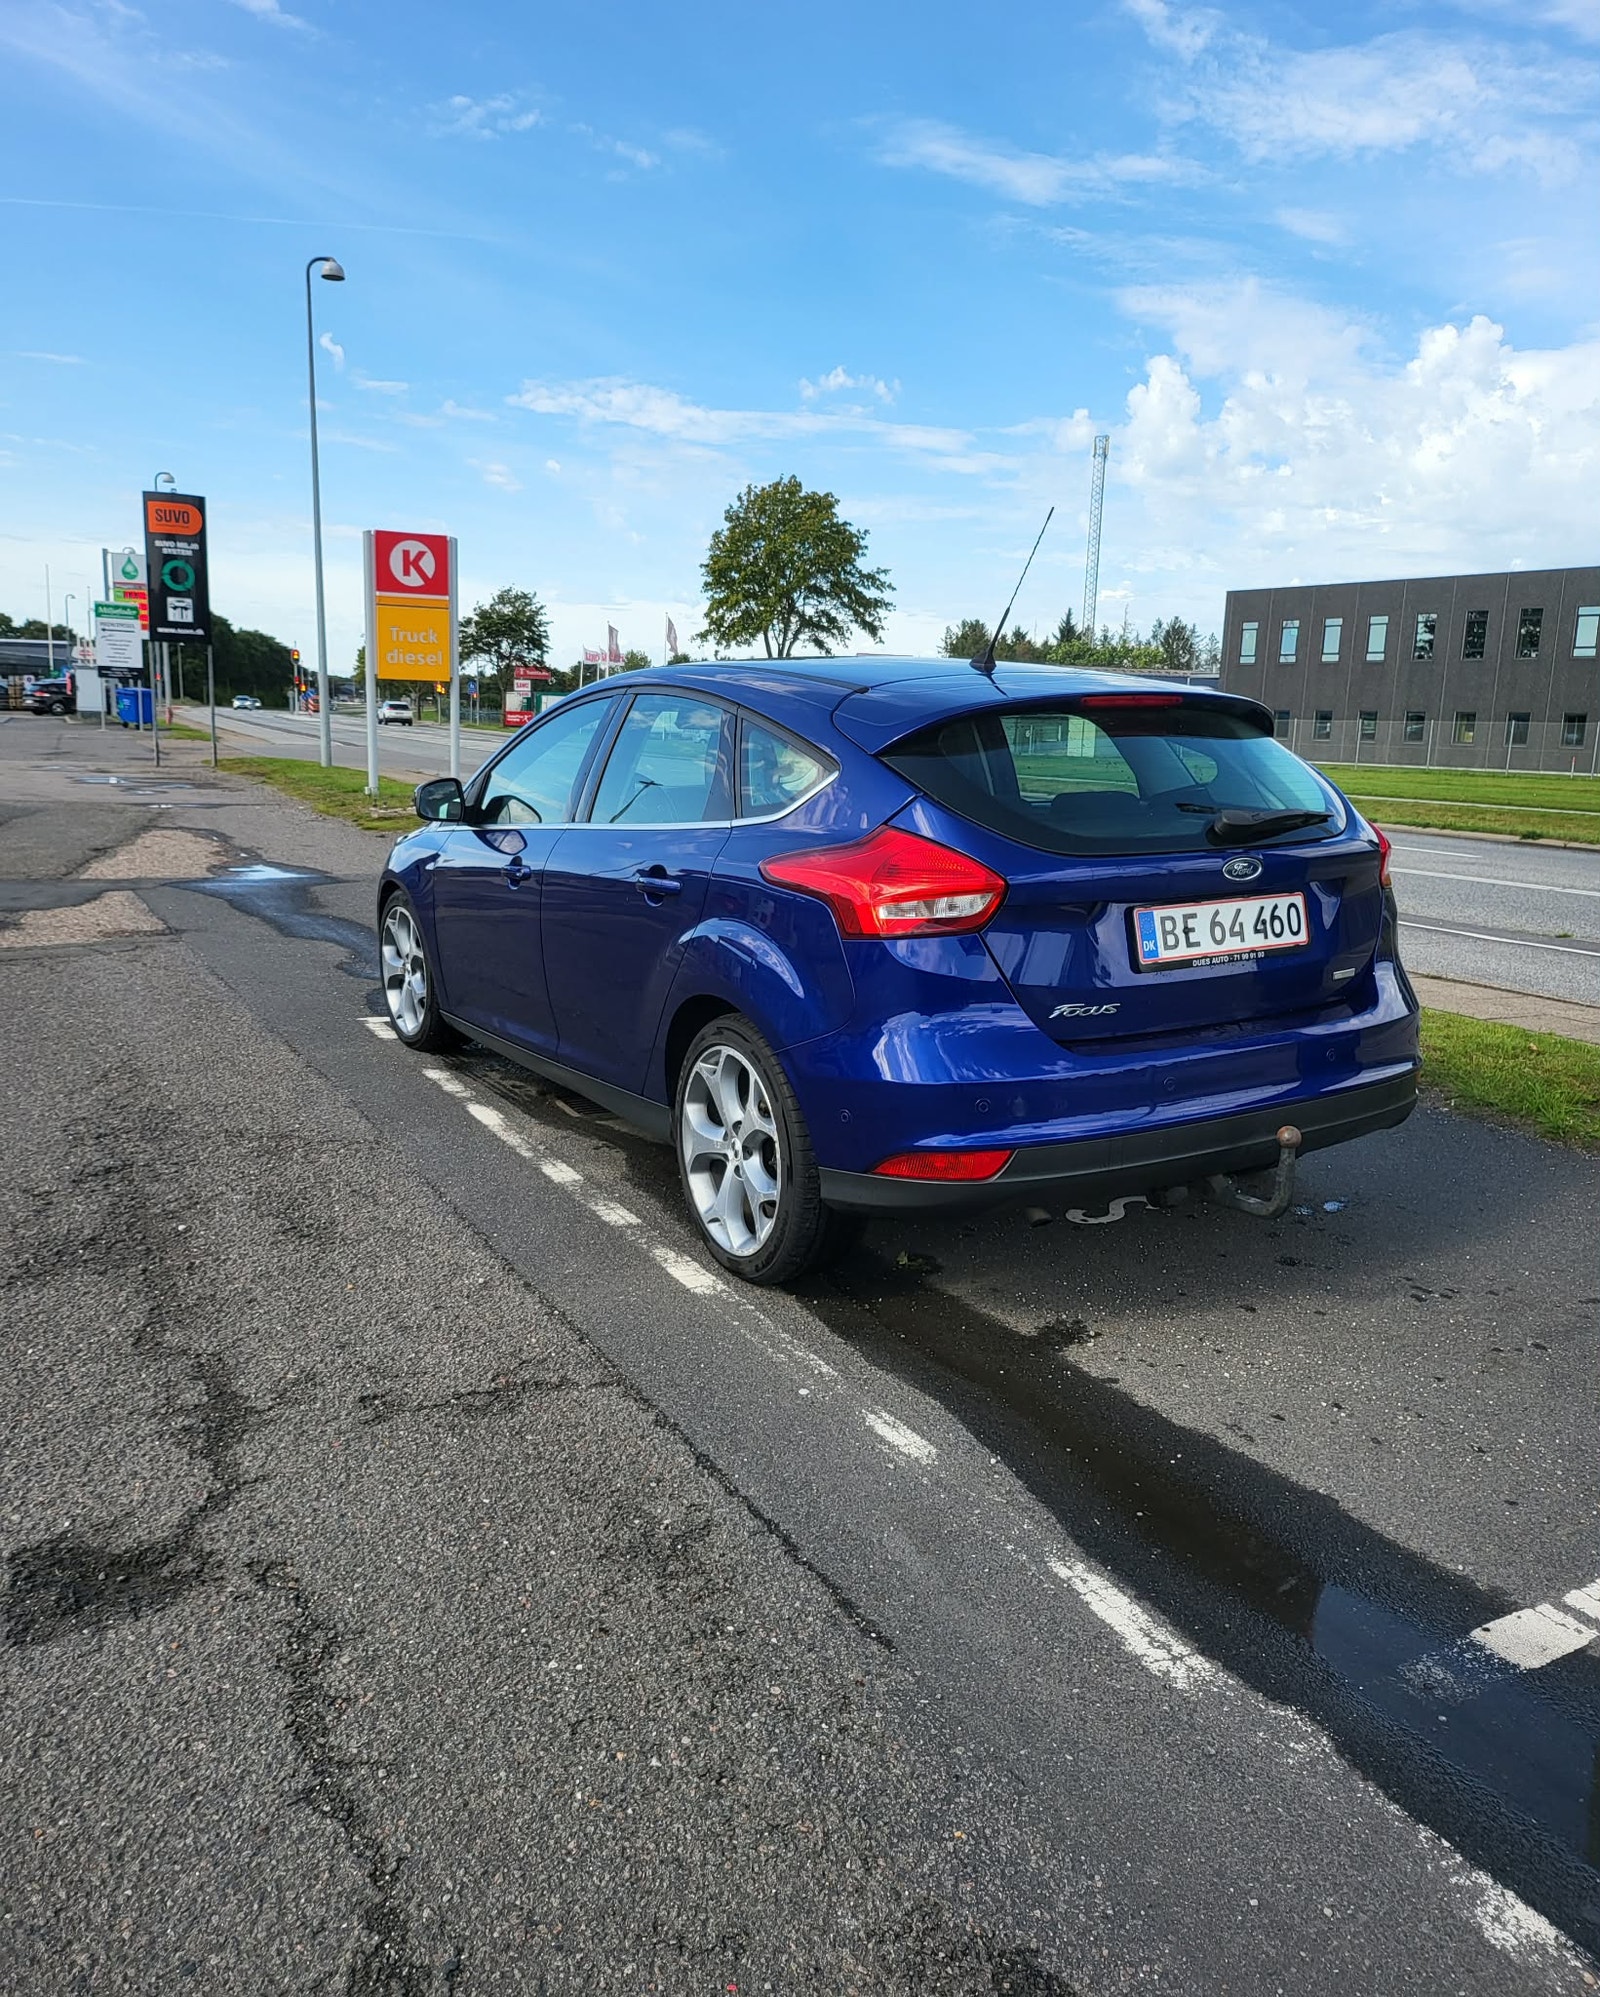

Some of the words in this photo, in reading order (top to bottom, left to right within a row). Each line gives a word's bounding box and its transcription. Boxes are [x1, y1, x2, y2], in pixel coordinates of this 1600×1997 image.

[155, 508, 190, 524] SUVO
[402, 549, 431, 582] K
[389, 626, 438, 644] Truck
[386, 648, 443, 667] diesel
[1232, 862, 1253, 875] Ford
[1143, 939, 1156, 952] DK
[1160, 913, 1201, 951] BE
[1209, 908, 1245, 946] 64
[1253, 902, 1302, 940] 460
[1193, 958, 1210, 968] DUES
[1211, 955, 1230, 964] AUTO
